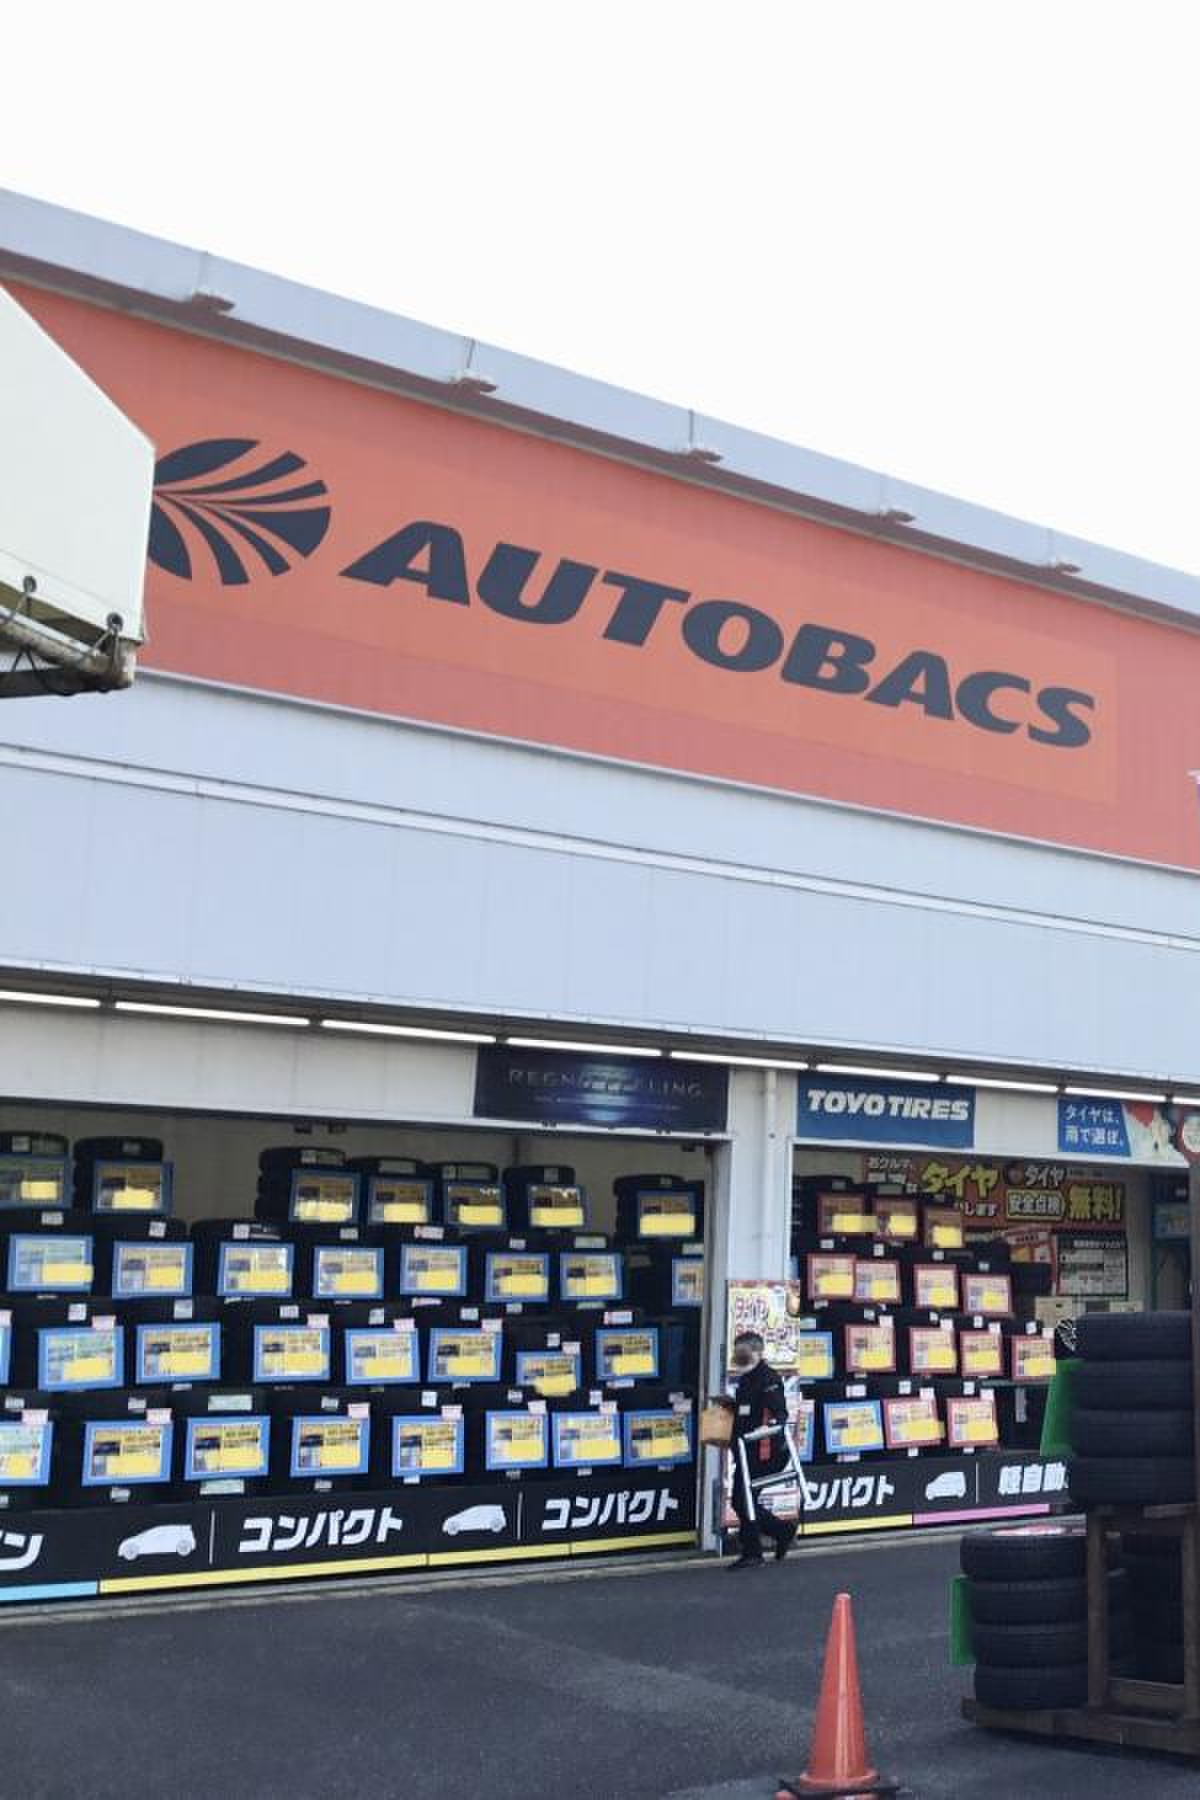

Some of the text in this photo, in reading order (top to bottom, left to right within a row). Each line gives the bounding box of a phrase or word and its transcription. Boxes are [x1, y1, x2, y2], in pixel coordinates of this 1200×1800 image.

[340, 520, 1096, 749] AUTOBACS
[887, 1096, 970, 1121] TIRES
[920, 1160, 999, 1197] タイヤ
[804, 1474, 895, 1511] ンパクト
[998, 1461, 1069, 1496] 軽自動
[541, 1488, 678, 1531] コンパクト
[238, 1506, 402, 1553] コンパクト
[0, 1529, 44, 1571] ン
